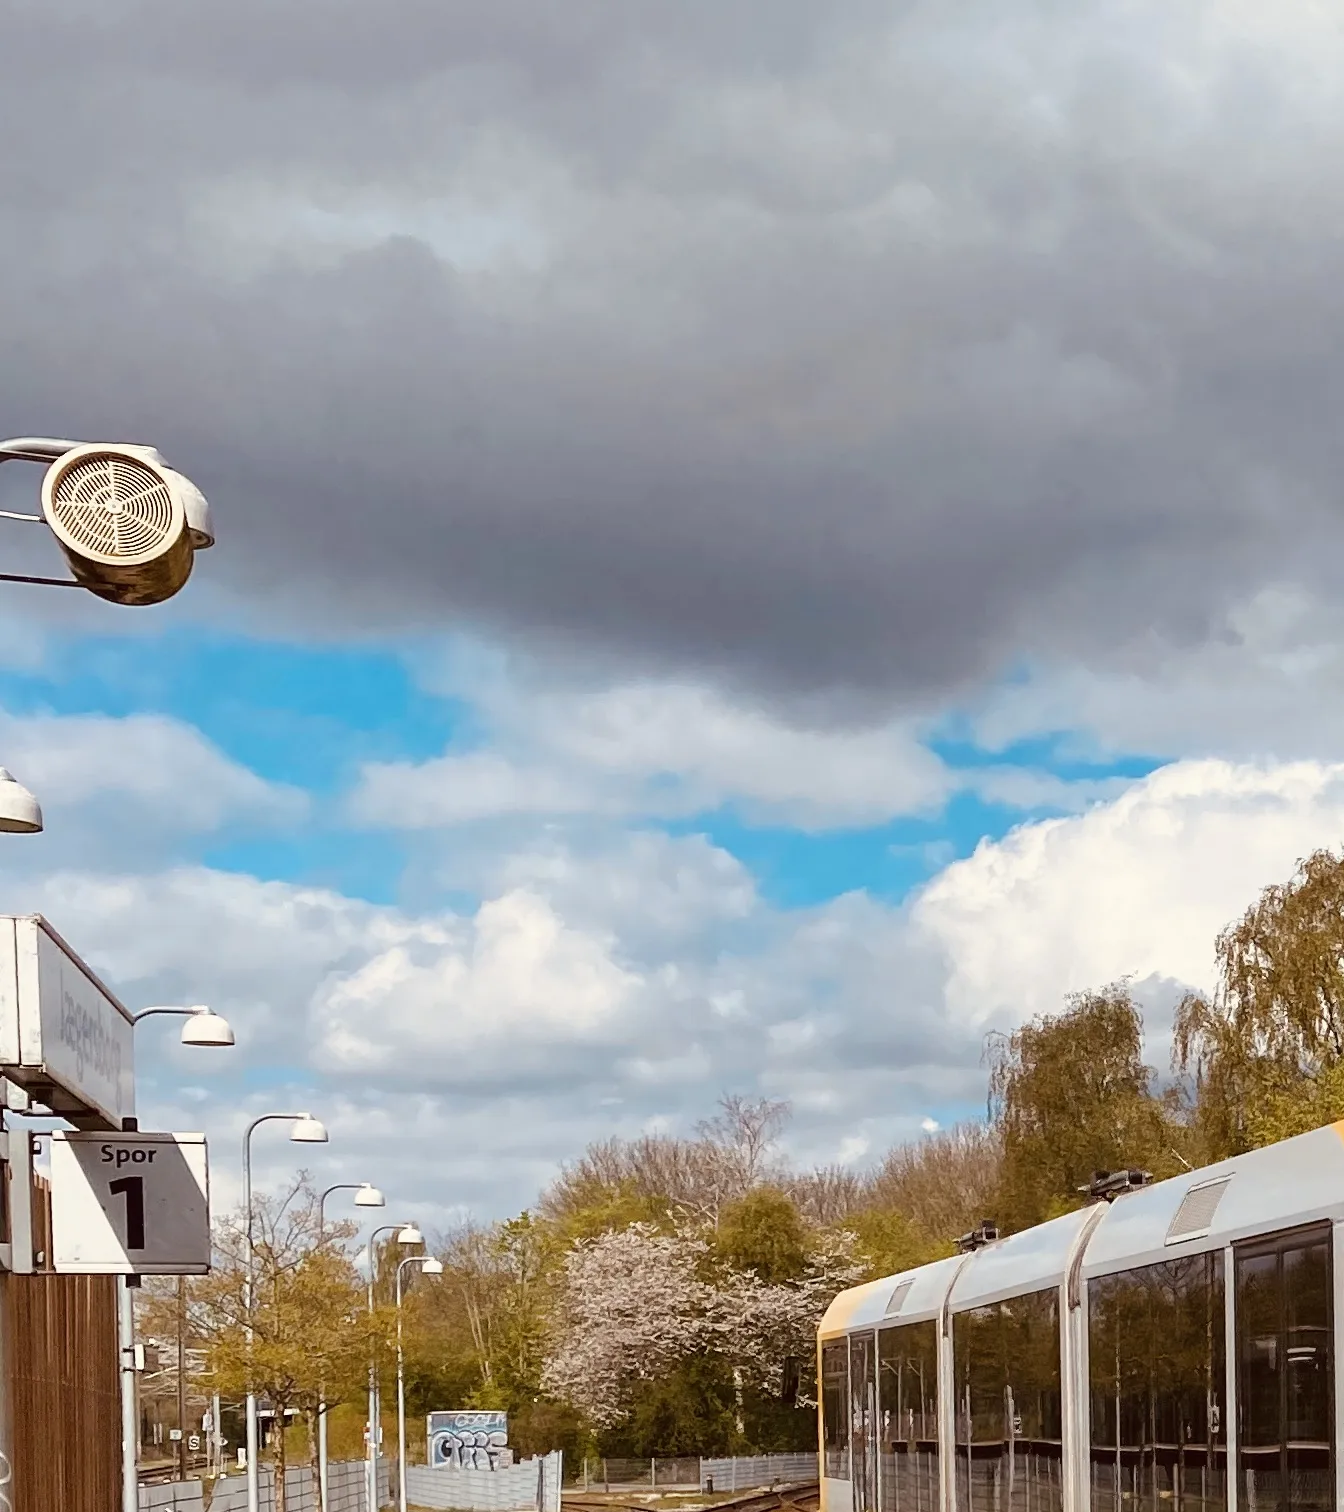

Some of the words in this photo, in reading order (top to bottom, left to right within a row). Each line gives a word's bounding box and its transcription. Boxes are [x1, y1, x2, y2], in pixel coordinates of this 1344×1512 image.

[101, 1144, 157, 1168] Spor
[108, 1175, 145, 1250] 1
[190, 1438, 199, 1448] S
